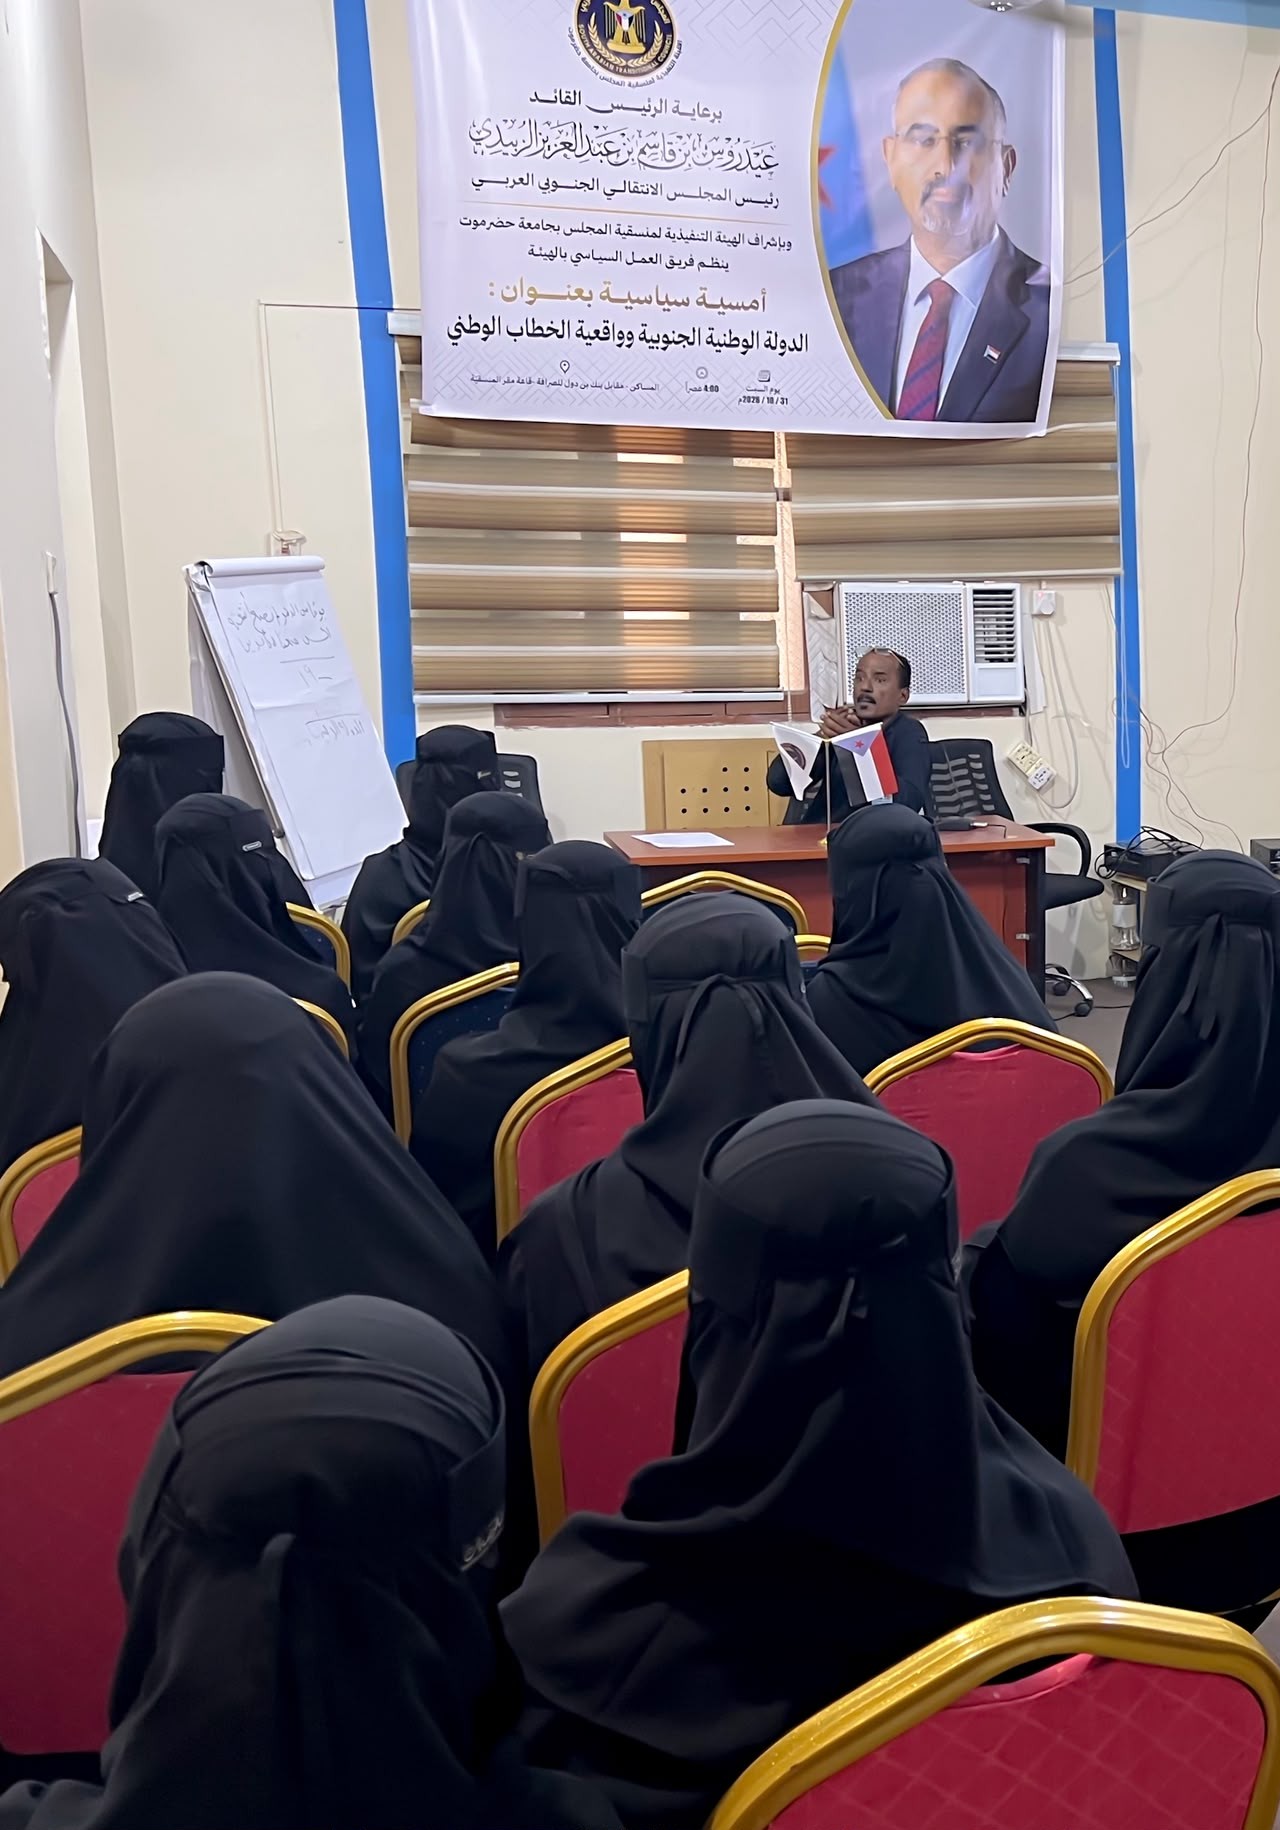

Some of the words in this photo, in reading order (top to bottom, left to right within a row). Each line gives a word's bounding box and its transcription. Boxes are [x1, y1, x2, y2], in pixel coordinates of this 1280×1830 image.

[578, 24, 591, 49] SOUTH
[589, 48, 616, 70] ARABIAN
[657, 34, 672, 62] COUNCIL
[529, 88, 582, 106] القائد
[585, 97, 668, 119] الرئيس
[672, 99, 723, 124] برعاية
[471, 173, 534, 191] العربي
[538, 177, 600, 195] الجنوبي
[603, 179, 662, 201] الانتقالي
[666, 186, 731, 202] المجلس
[735, 192, 779, 209] رئيس
[459, 217, 515, 230] حضرموت
[518, 217, 560, 235] بجامعة
[563, 221, 612, 237] المجلس
[615, 223, 662, 239] لمنسقية
[665, 227, 713, 244] التنفيذية
[715, 231, 745, 248] الهيئة
[748, 233, 792, 252] وبإشراف
[528, 244, 567, 261] بالهيئة
[570, 248, 622, 267] السياسي
[625, 251, 662, 266] العمل
[665, 254, 695, 270] فريق
[697, 256, 729, 273] ينظم
[500, 276, 594, 308] بعنوان
[599, 281, 690, 312] سياسية
[695, 286, 767, 316] أمسية
[447, 314, 501, 347] الوطني
[506, 316, 571, 343] الخطاب
[575, 319, 635, 349] وواقعية
[638, 323, 701, 351] الجنوبية
[705, 327, 760, 356] الوطنية
[763, 330, 809, 356] الدولة
